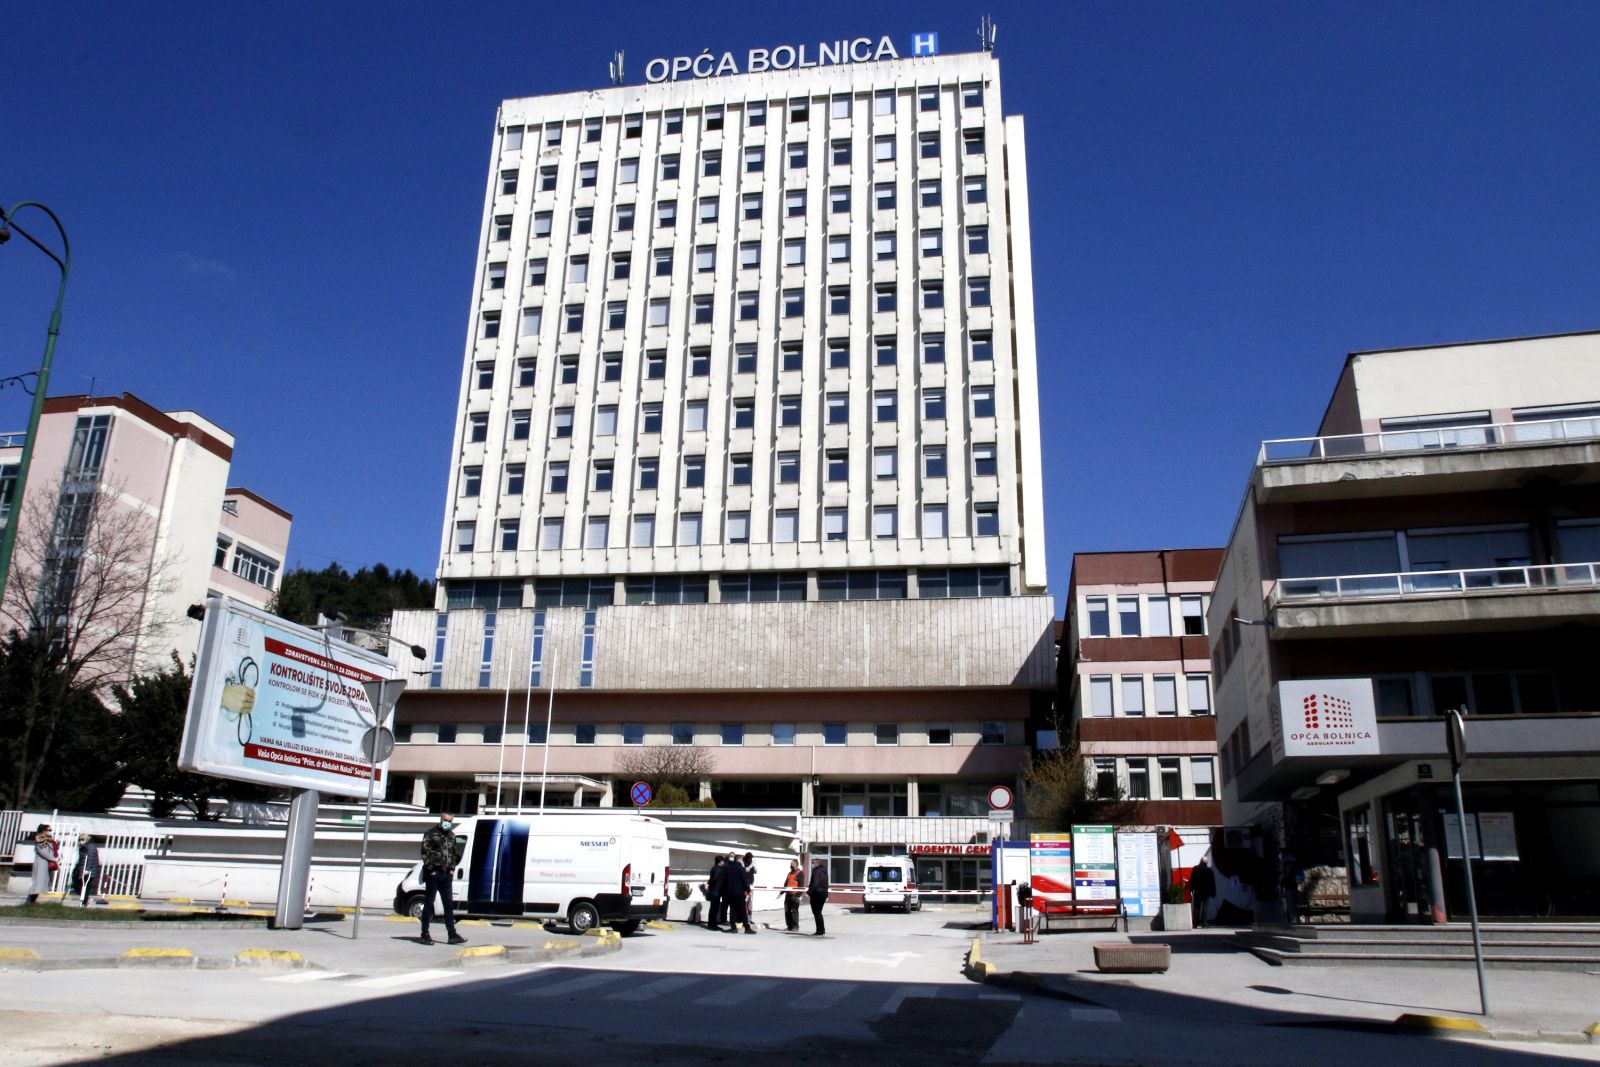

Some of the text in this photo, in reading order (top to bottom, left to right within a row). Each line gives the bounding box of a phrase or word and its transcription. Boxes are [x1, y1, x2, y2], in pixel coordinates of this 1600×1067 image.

[645, 34, 935, 83] OPĆA BOLNICA H
[285, 648, 320, 666] ZDRAVSTVENA
[345, 668, 360, 678] ZDRAV
[268, 679, 300, 694] KONTROLOM
[308, 690, 319, 699] RIZIK
[270, 662, 324, 688] KONTROLIŠITE
[325, 680, 347, 696] SVOJE
[284, 741, 299, 750] USLUZI
[1291, 731, 1320, 740] OPĆA
[257, 748, 270, 758] Vaša
[270, 751, 283, 762] Opća
[284, 754, 301, 764] bolnica
[322, 761, 340, 770] Abdulah
